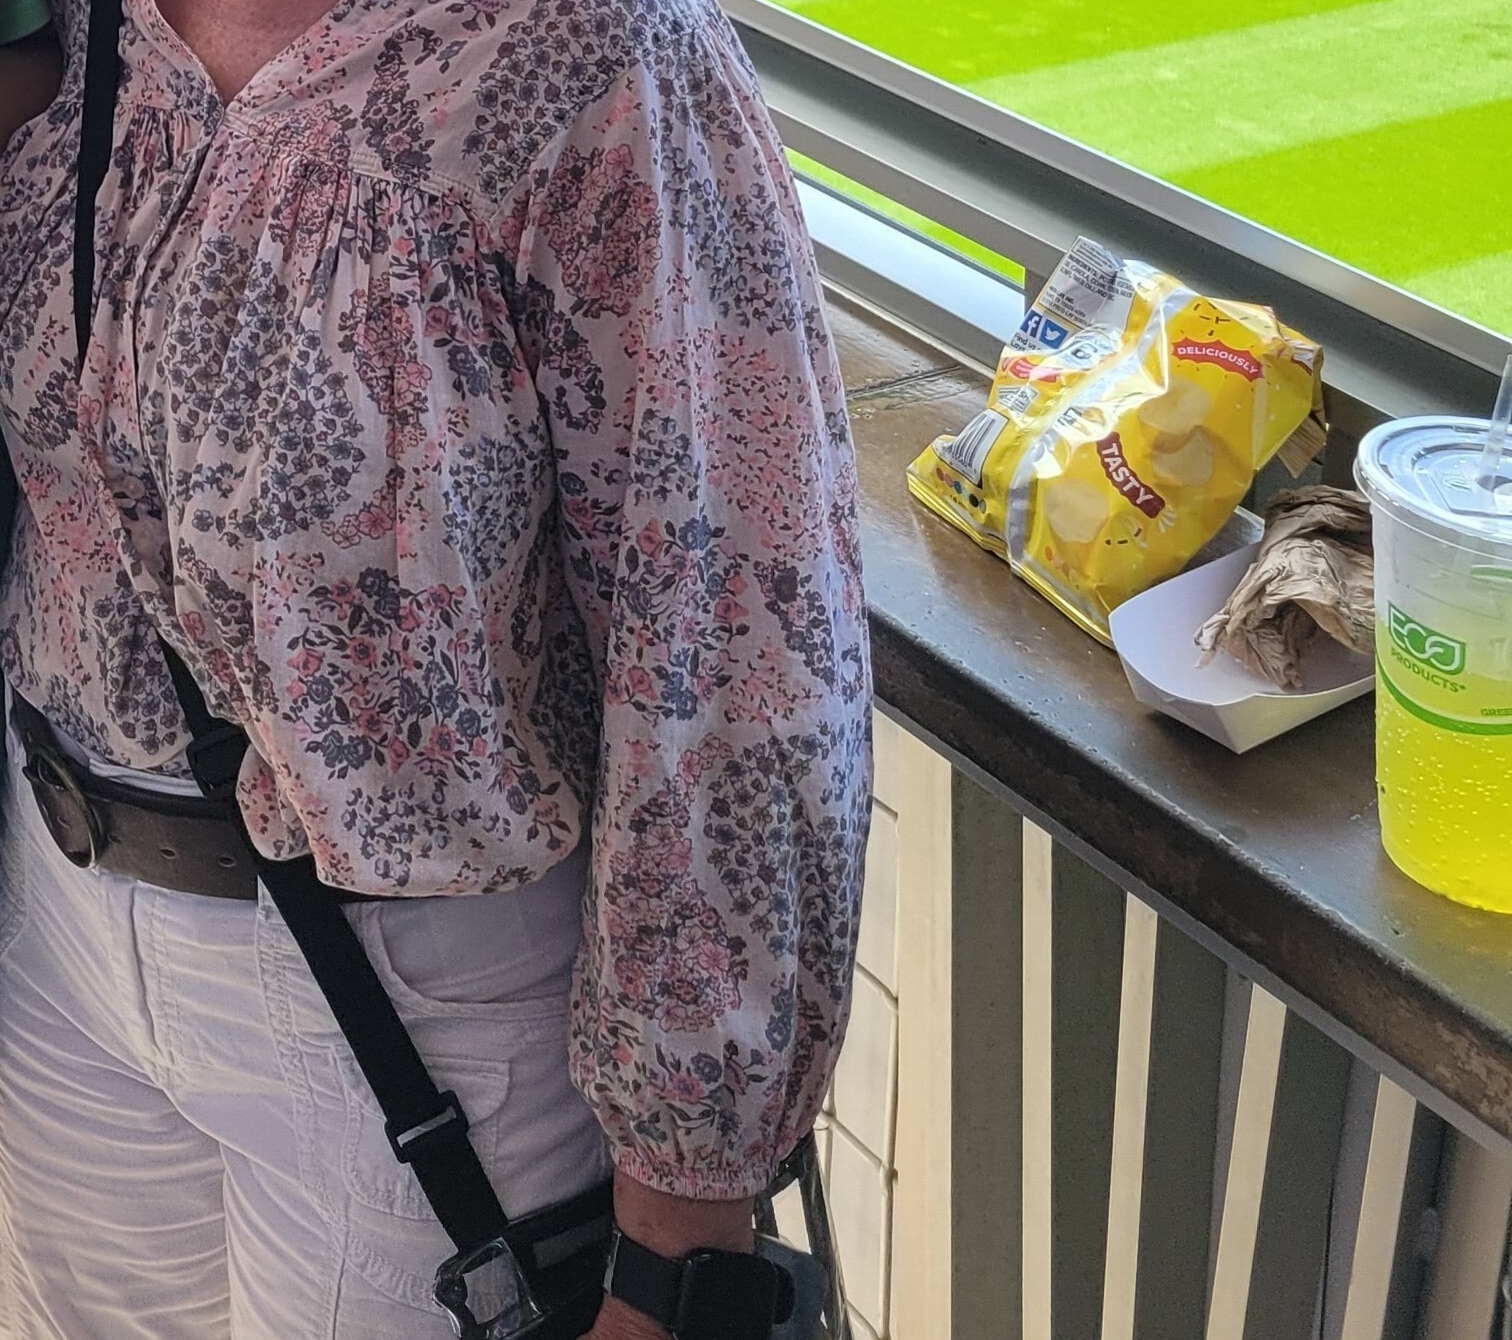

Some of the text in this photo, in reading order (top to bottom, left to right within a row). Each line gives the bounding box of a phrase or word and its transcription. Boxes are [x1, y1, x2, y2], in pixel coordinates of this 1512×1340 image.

[1013, 332, 1037, 351] Find us
[1176, 346, 1259, 375] DELICIOUSLY
[1101, 442, 1155, 505] TASTY
[1481, 707, 1512, 717] GREE
